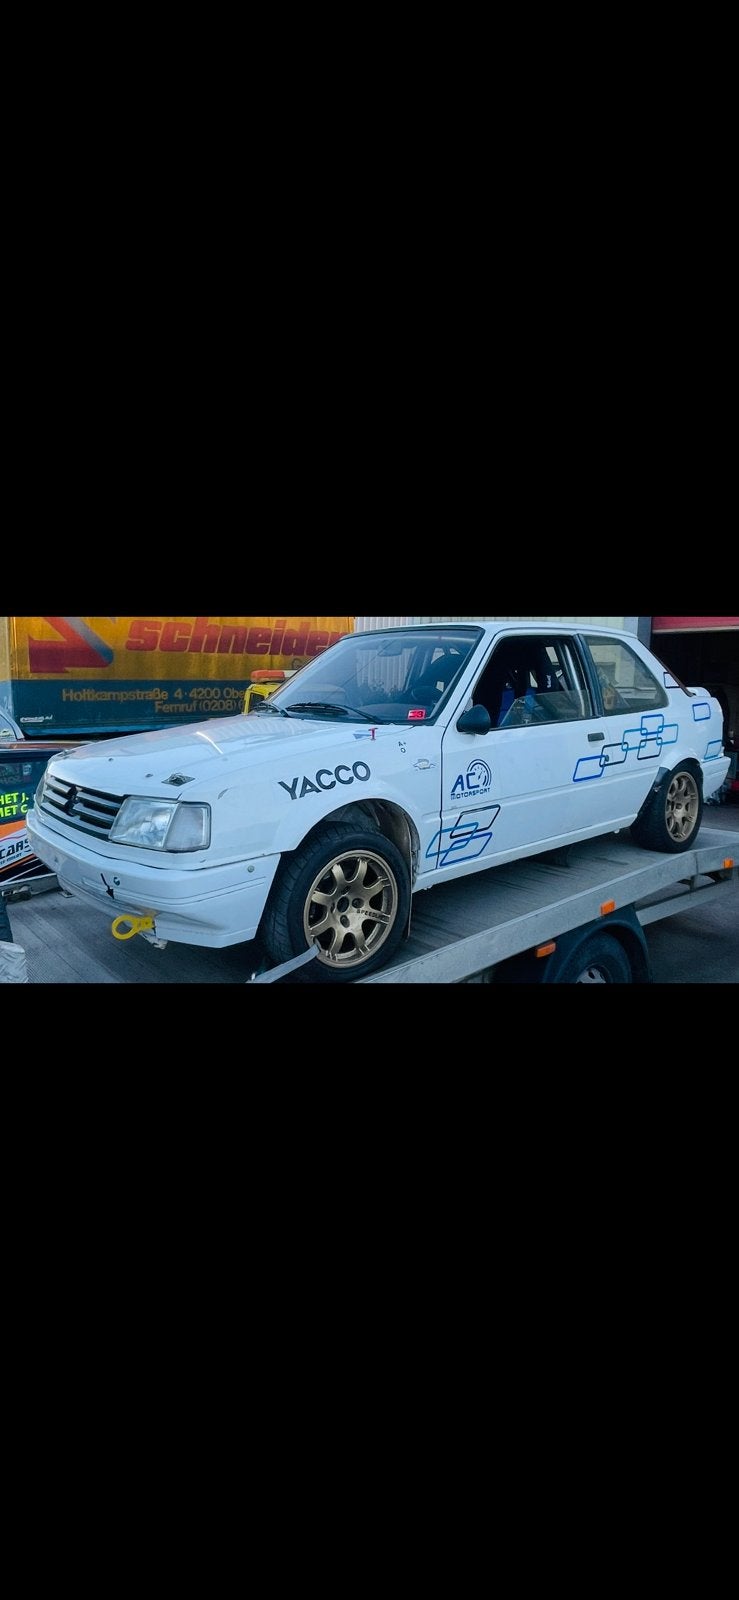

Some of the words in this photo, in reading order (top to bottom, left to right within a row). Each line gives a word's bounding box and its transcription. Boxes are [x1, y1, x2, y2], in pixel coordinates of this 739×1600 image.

[62, 688, 168, 703] Holtkampstraße
[154, 700, 197, 713] Fernruf
[277, 761, 371, 800] YACCO
[450, 769, 480, 793] AC
[450, 787, 490, 800] MOTORSPORT
[356, 908, 389, 922] SPEEDL
